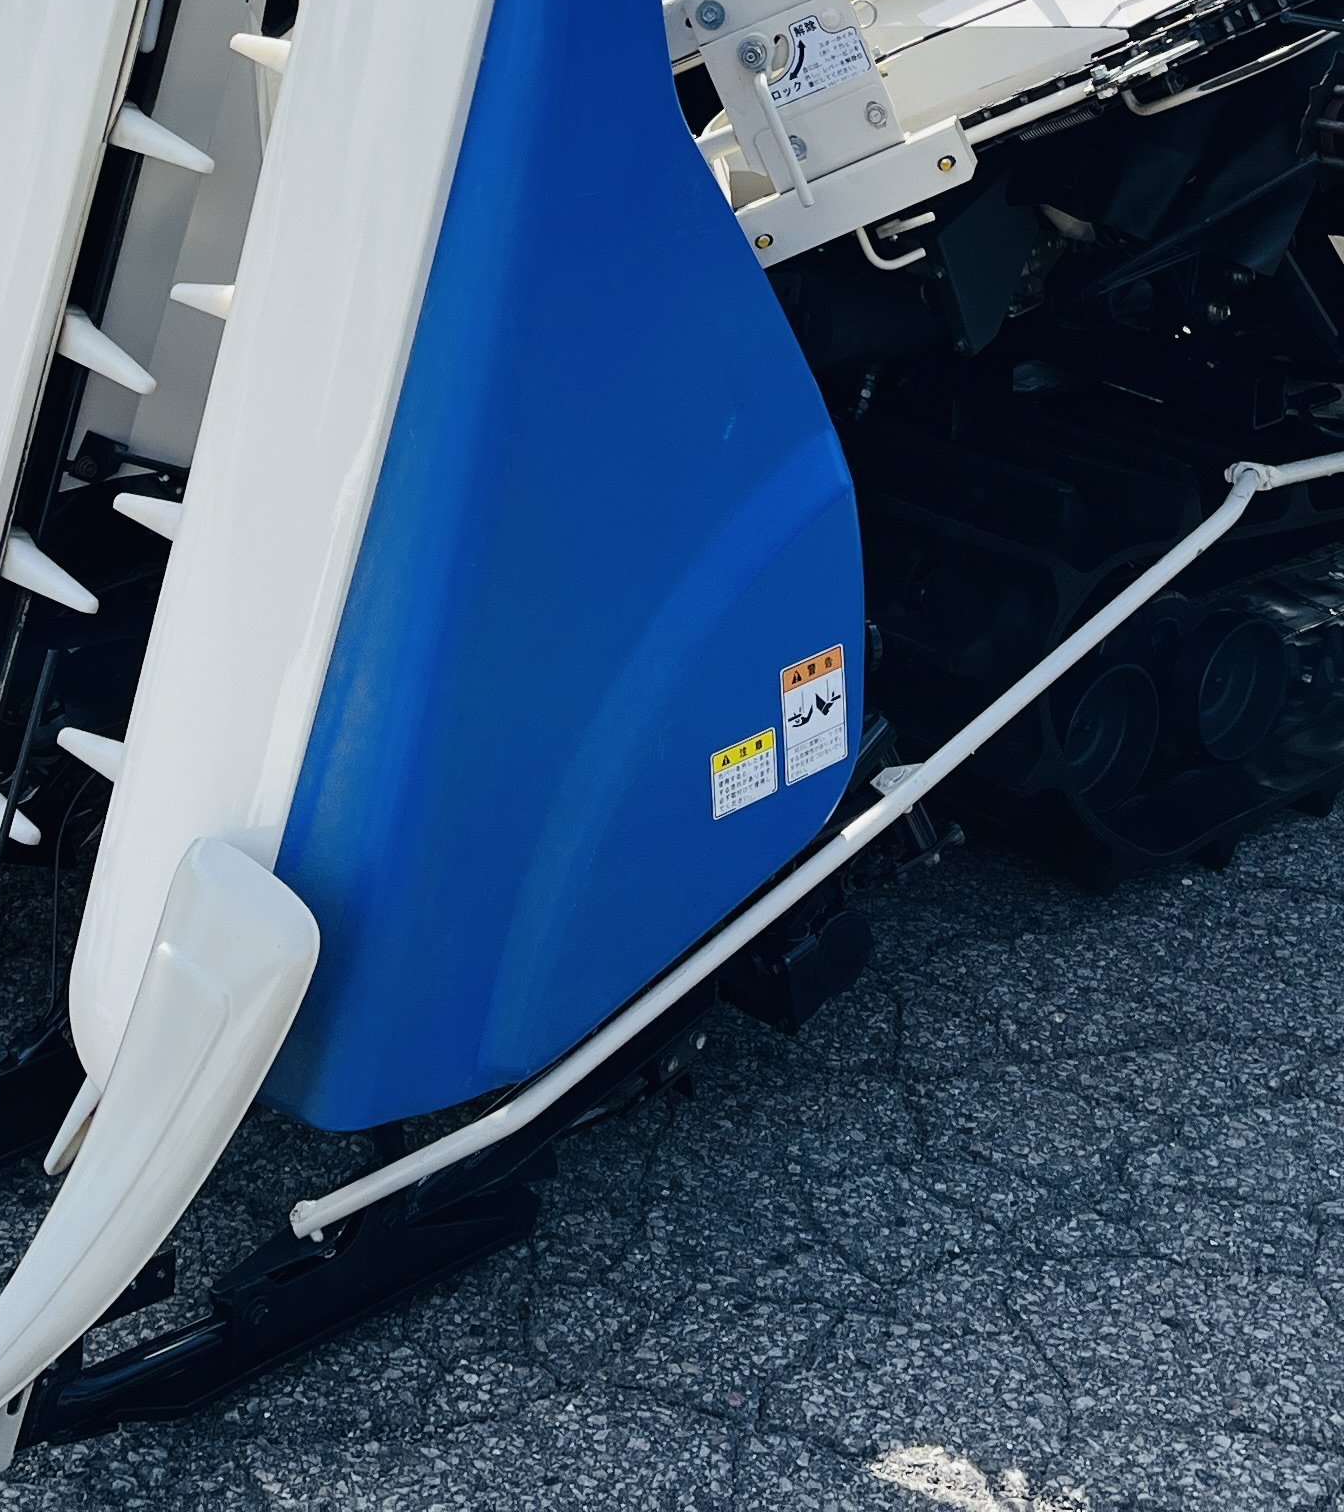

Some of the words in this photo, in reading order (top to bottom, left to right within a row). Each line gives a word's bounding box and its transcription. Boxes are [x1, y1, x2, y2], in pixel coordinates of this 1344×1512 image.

[794, 20, 817, 37] 解除
[771, 82, 801, 101] ロック
[739, 739, 762, 758] 注意
